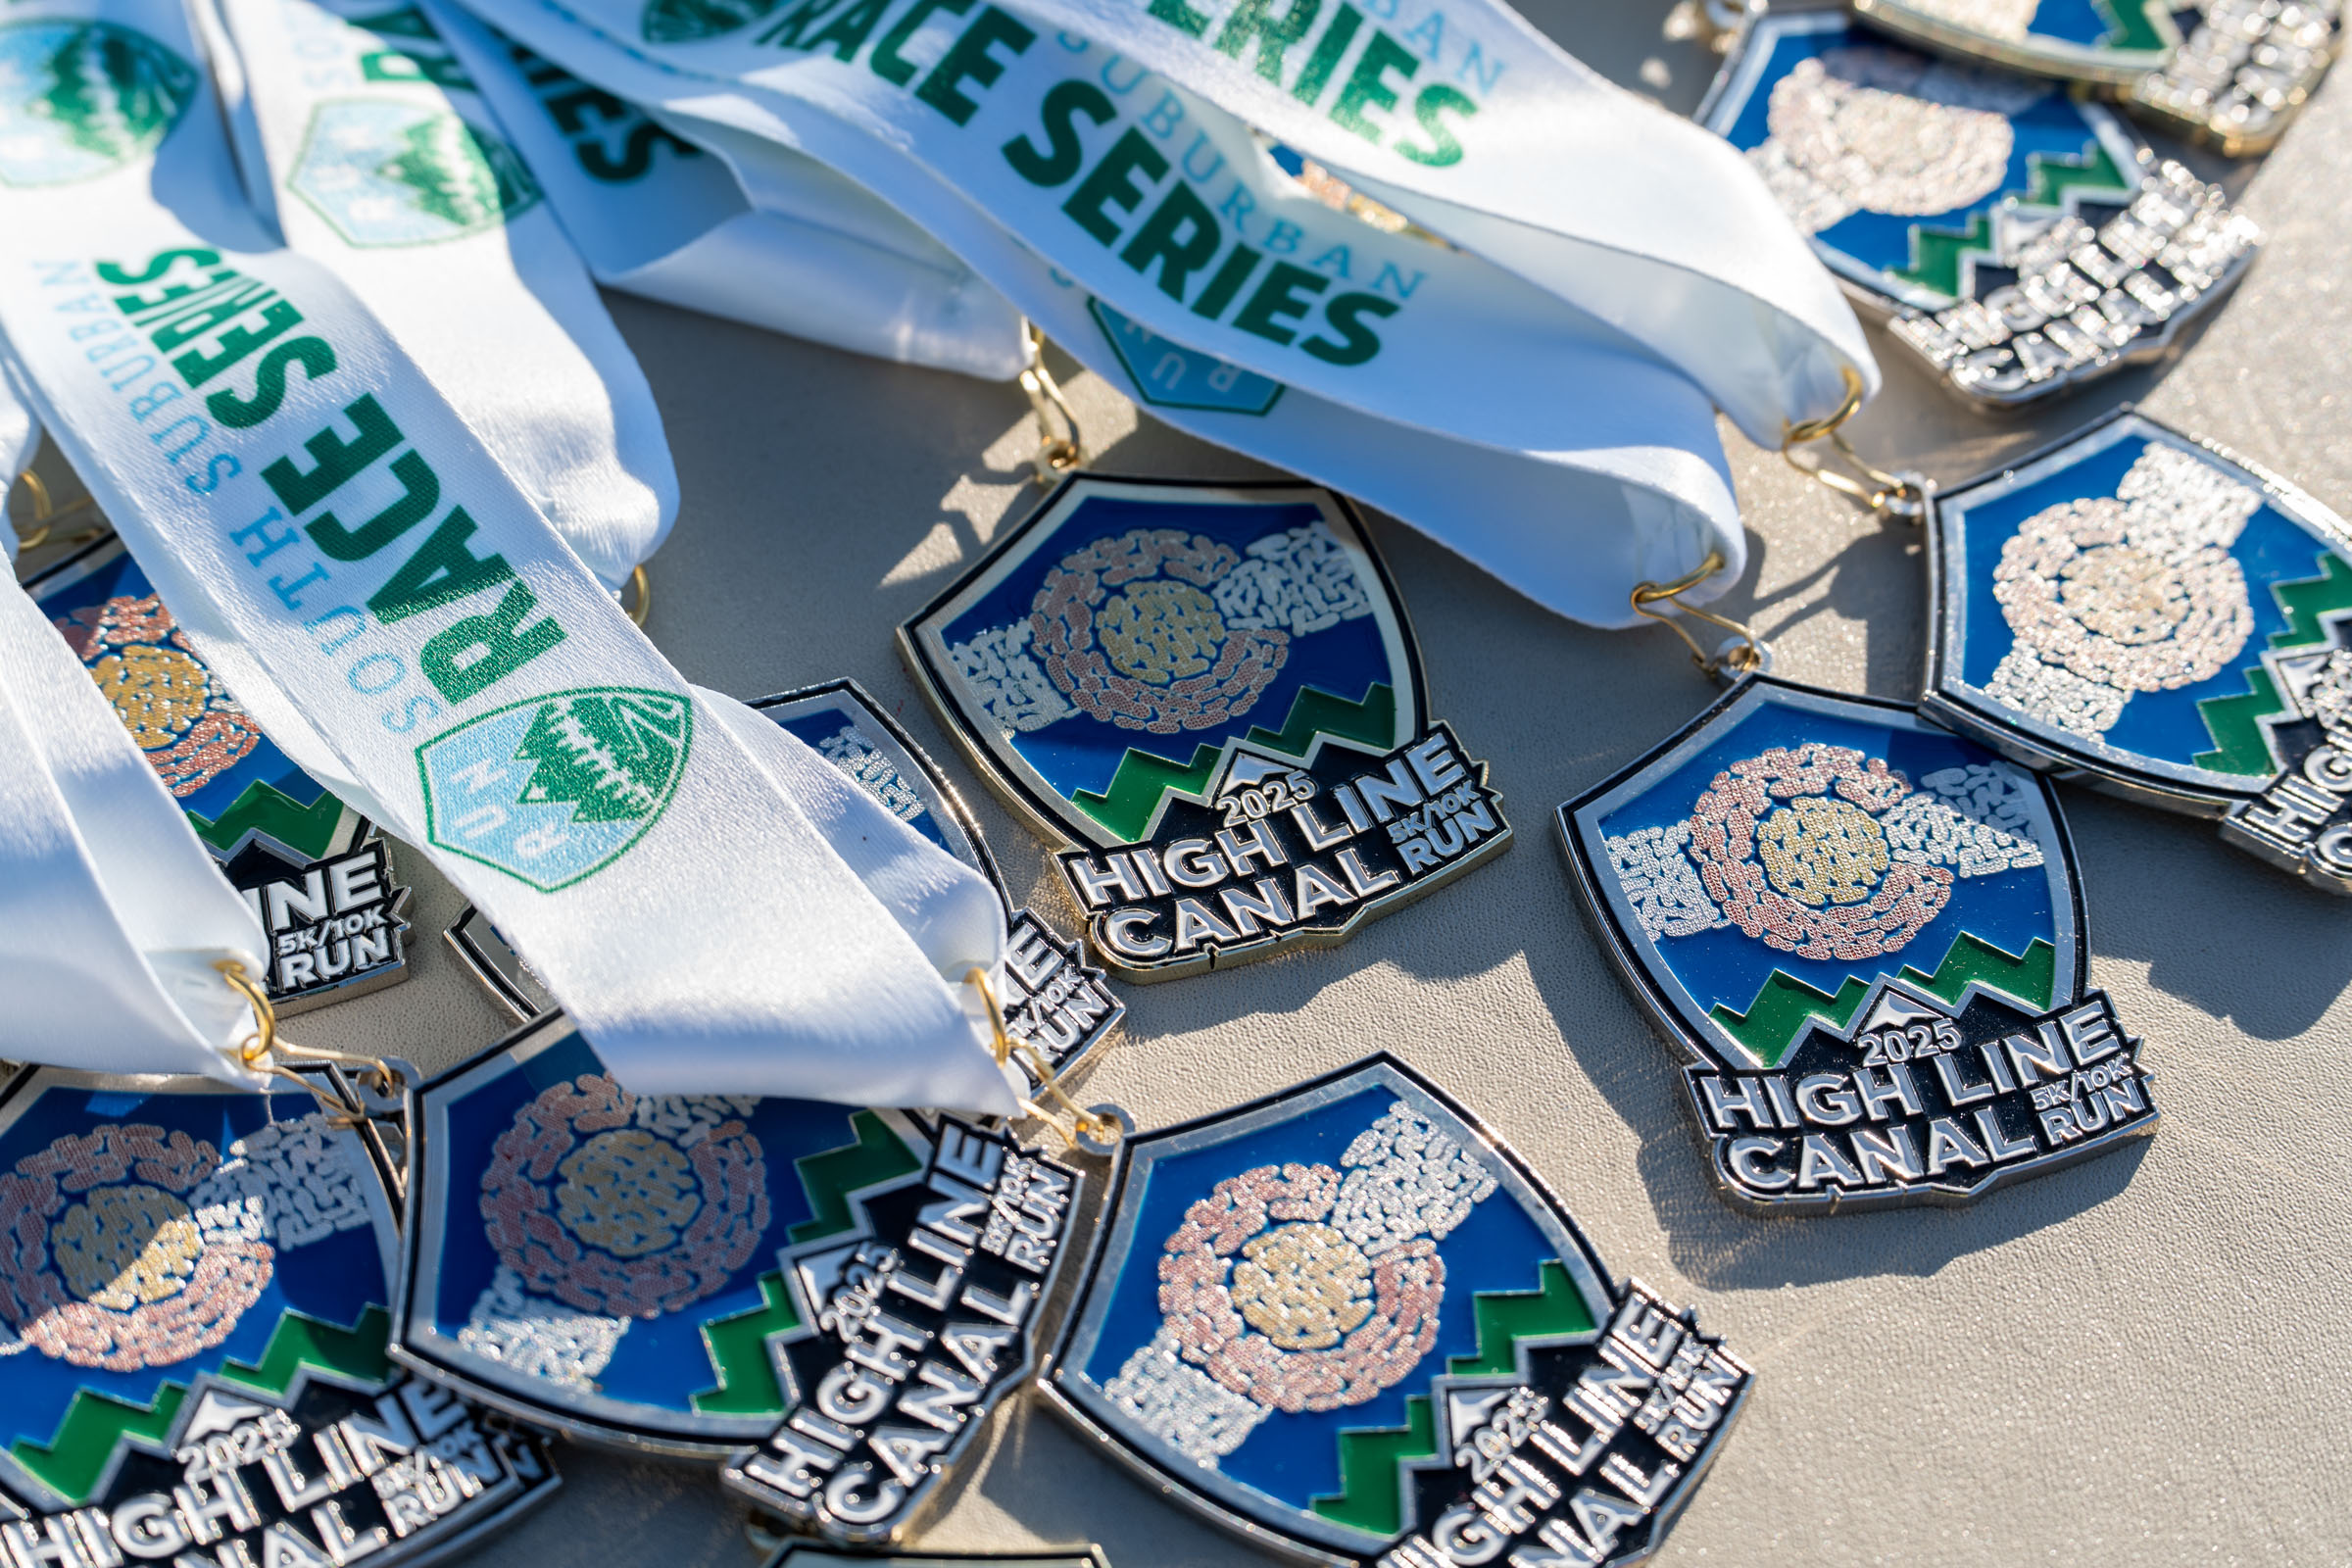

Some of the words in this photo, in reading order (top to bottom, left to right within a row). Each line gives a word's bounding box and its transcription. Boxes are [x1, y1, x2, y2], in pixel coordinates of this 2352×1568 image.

[1149, 0, 1478, 168] RIES
[1000, 79, 1401, 367] SERIES
[32, 261, 242, 496] SUBURBAN
[94, 248, 338, 429] SERIES
[260, 392, 569, 706] RACE
[229, 505, 441, 733] SOUTH
[449, 758, 571, 859] RUN
[1069, 817, 1289, 906] HIGH
[1290, 733, 1467, 851] LINE
[1215, 770, 1318, 827] 2025
[1389, 781, 1481, 844] 5K/10K
[2244, 723, 2352, 845] HIG
[241, 851, 385, 932] INE
[1396, 802, 1498, 877] RUN
[277, 904, 388, 956] 5K/10K
[1103, 848, 1401, 957] CANAL
[280, 927, 390, 991] RUN
[1006, 963, 1085, 1038] K/10K
[1012, 981, 1109, 1079] RUN
[1699, 1062, 1924, 1129] HIGH
[1934, 1000, 2121, 1106] LINE
[1857, 1018, 1961, 1067] 2025
[2028, 1053, 2134, 1112] 5K/10K
[1728, 1104, 2037, 1191] CANAL
[2036, 1075, 2146, 1147] RUN
[1004, 1161, 1071, 1274] RUN
[746, 1310, 935, 1498] HIGH
[885, 1124, 1004, 1311] LINE
[819, 1240, 899, 1344] 2025
[825, 1279, 1040, 1525] CANAL
[1455, 1386, 1549, 1485] 2025
[1529, 1292, 1685, 1476] LINE
[1654, 1348, 1742, 1462] RUN
[1, 1467, 262, 1568] HIGH
[262, 1380, 469, 1513] LINE
[174, 1407, 301, 1483] 2025
[382, 1445, 503, 1538] RUN
[1508, 1451, 1680, 1568] NAL
